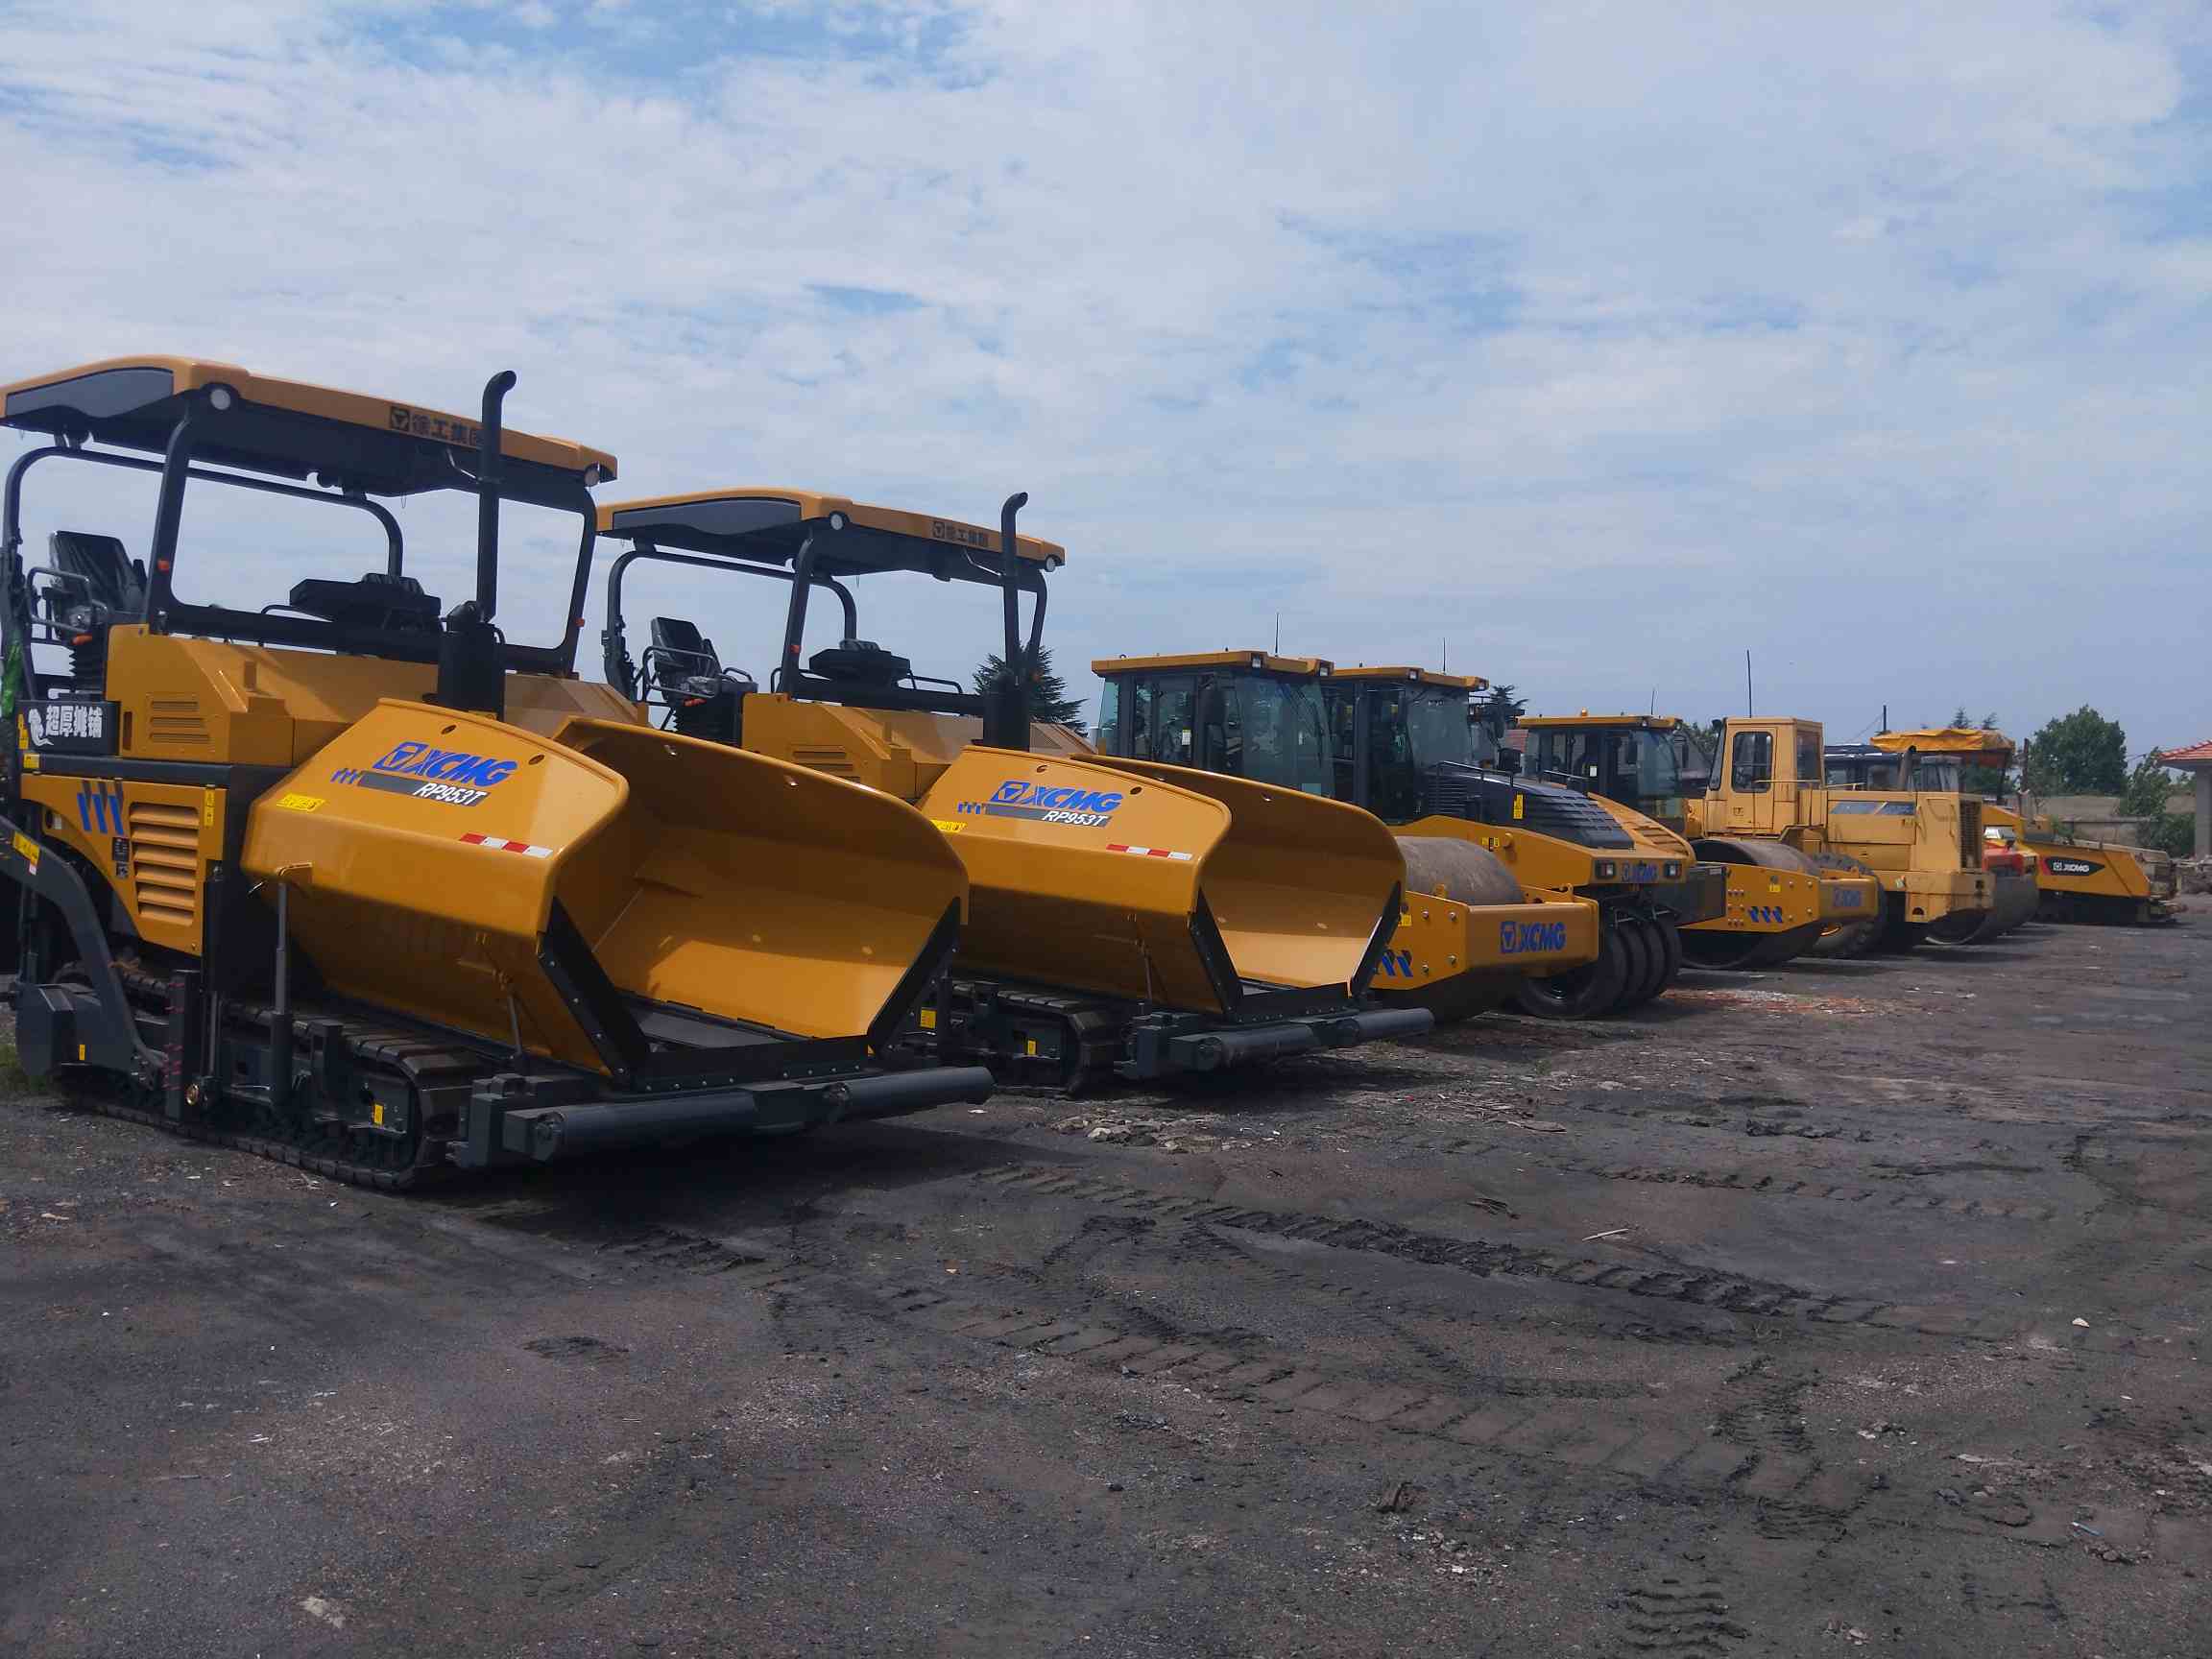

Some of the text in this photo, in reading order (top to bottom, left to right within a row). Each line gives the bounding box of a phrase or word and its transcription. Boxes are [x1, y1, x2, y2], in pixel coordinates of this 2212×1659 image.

[404, 749, 518, 787] XCMG
[413, 782, 489, 805] RP953T
[1020, 784, 1124, 813] XCMG
[1042, 810, 1109, 827] RP953T
[1520, 922, 1567, 953] XCMG
